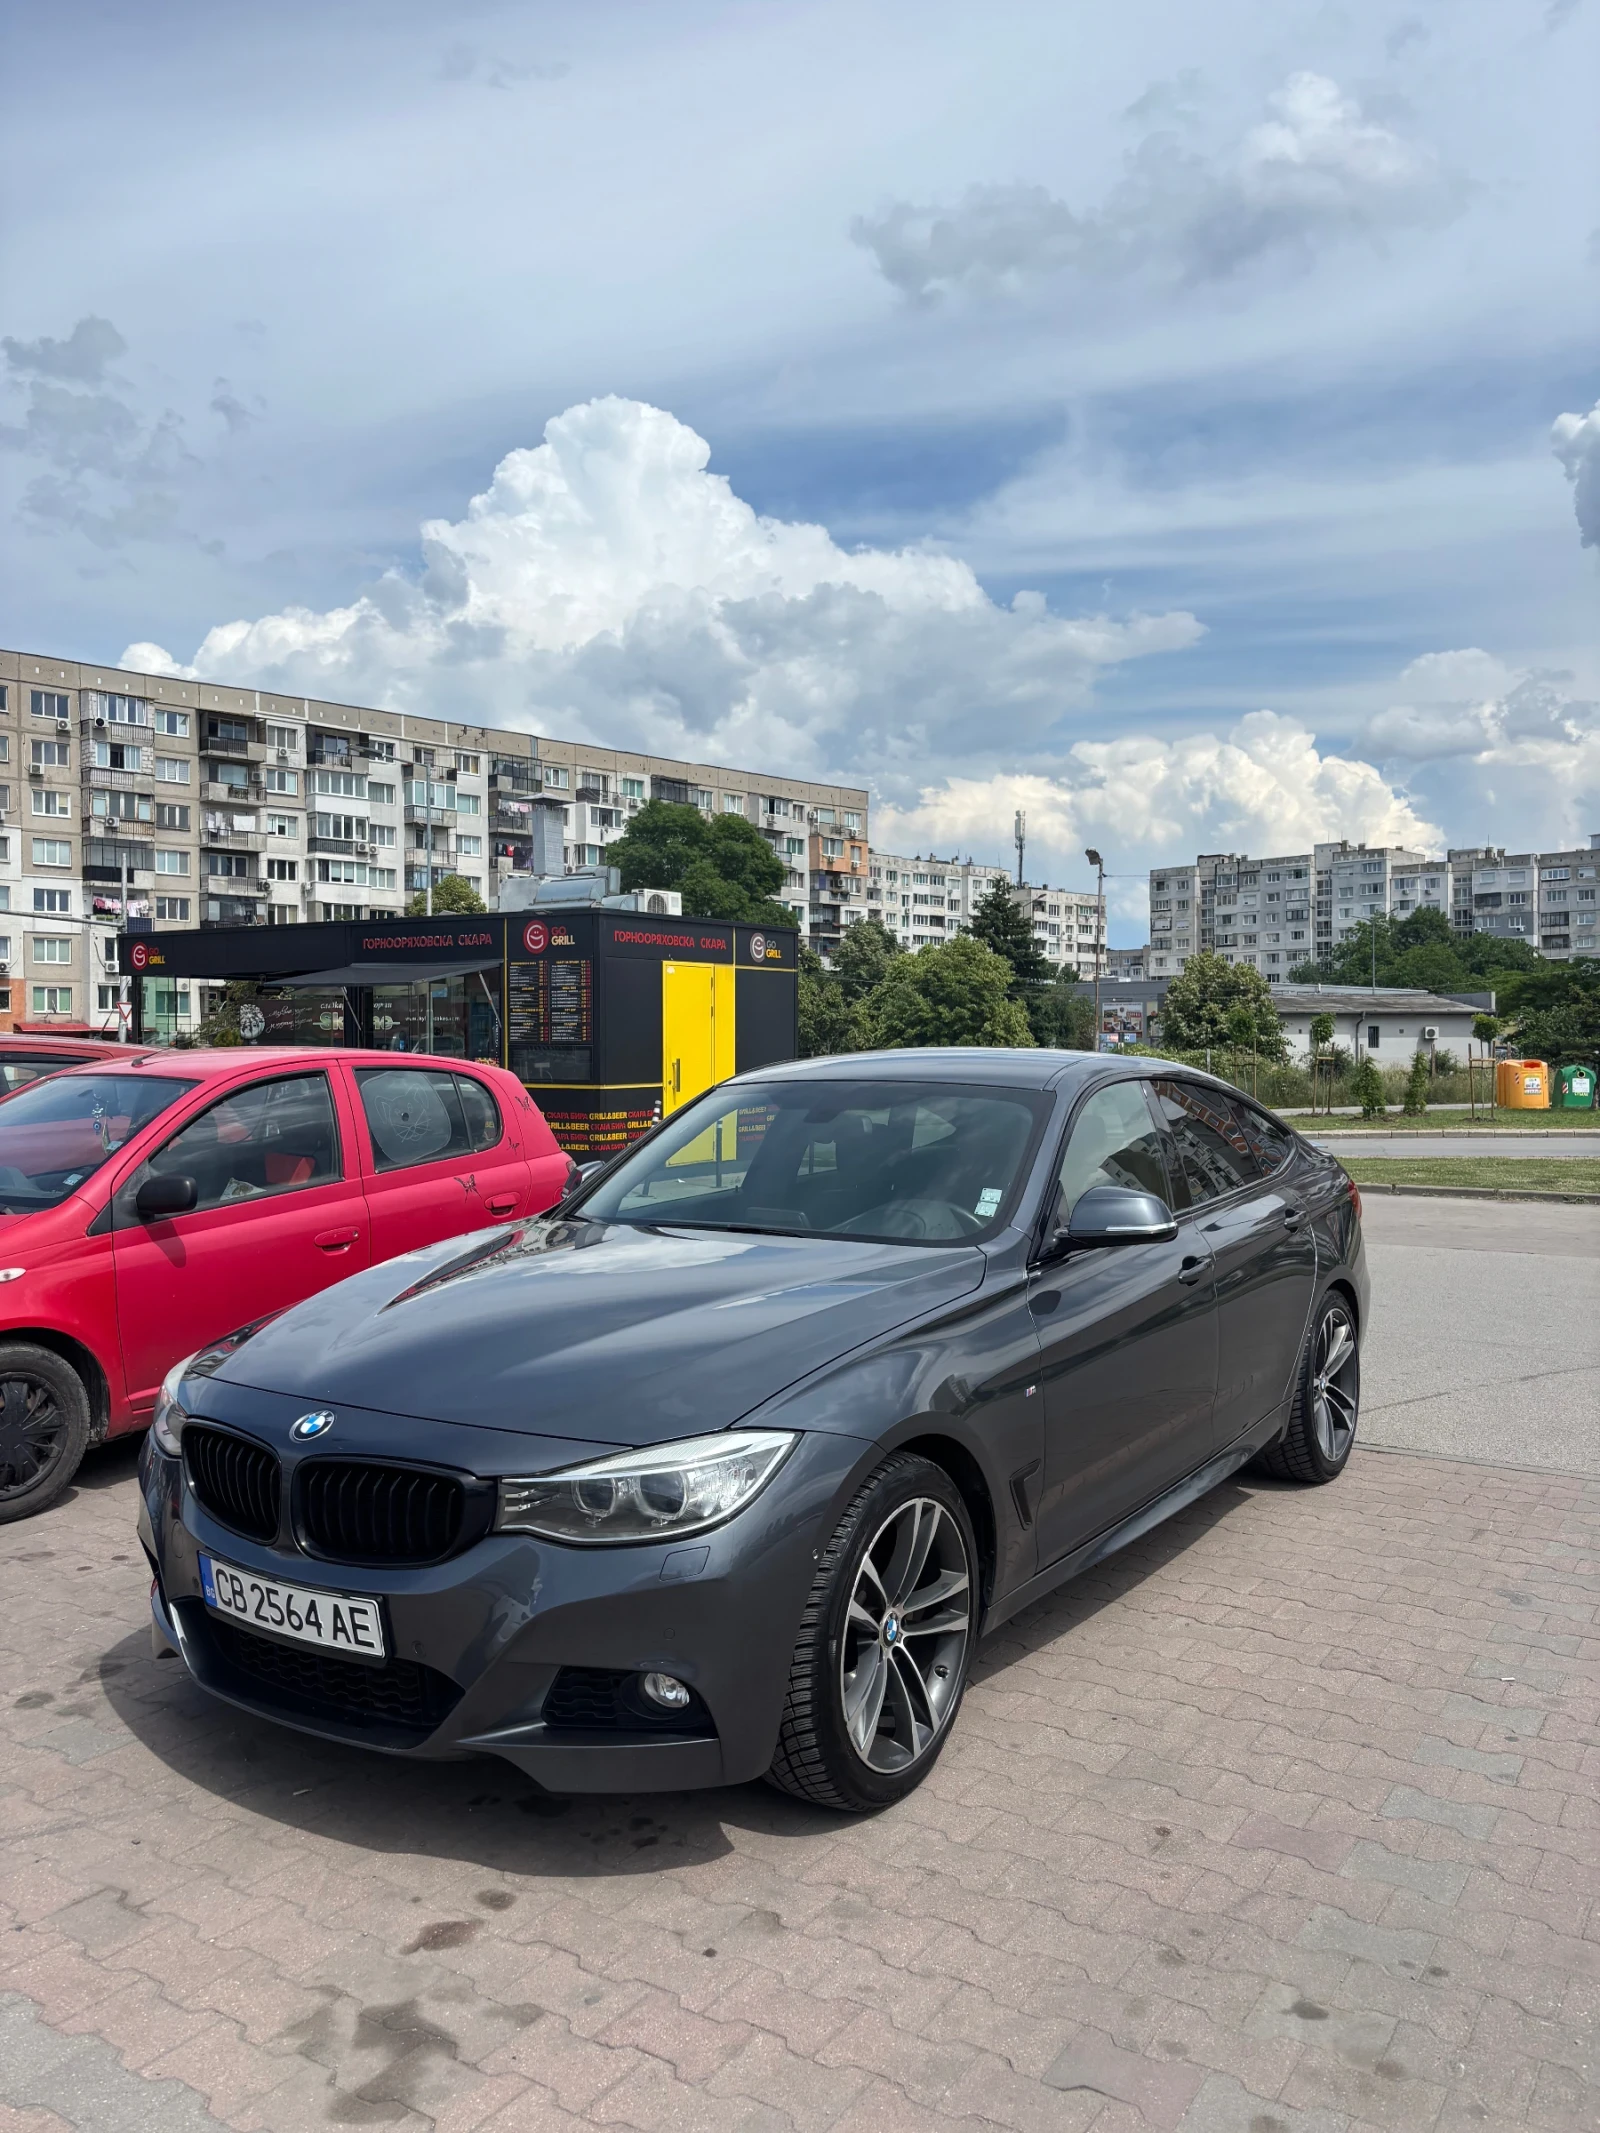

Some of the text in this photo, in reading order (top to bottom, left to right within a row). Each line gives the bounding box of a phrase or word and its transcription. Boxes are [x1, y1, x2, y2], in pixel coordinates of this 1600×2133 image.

[552, 926, 566, 935] GO
[363, 934, 493, 949] ГОРНООРЯХОВСКА СКАРА
[551, 935, 575, 946] GRILL
[614, 930, 727, 950] ГОРНООРЯХОВСКА СКАРА
[766, 940, 776, 948] GO
[766, 948, 782, 959] GRILL
[149, 955, 166, 965] GRILL
[589, 1111, 627, 1121] GRILL&BEER
[627, 1120, 652, 1130] GRILL&B
[589, 1132, 627, 1142] GRILL&BEER
[206, 1569, 376, 1650] BG CB 2564 AE
